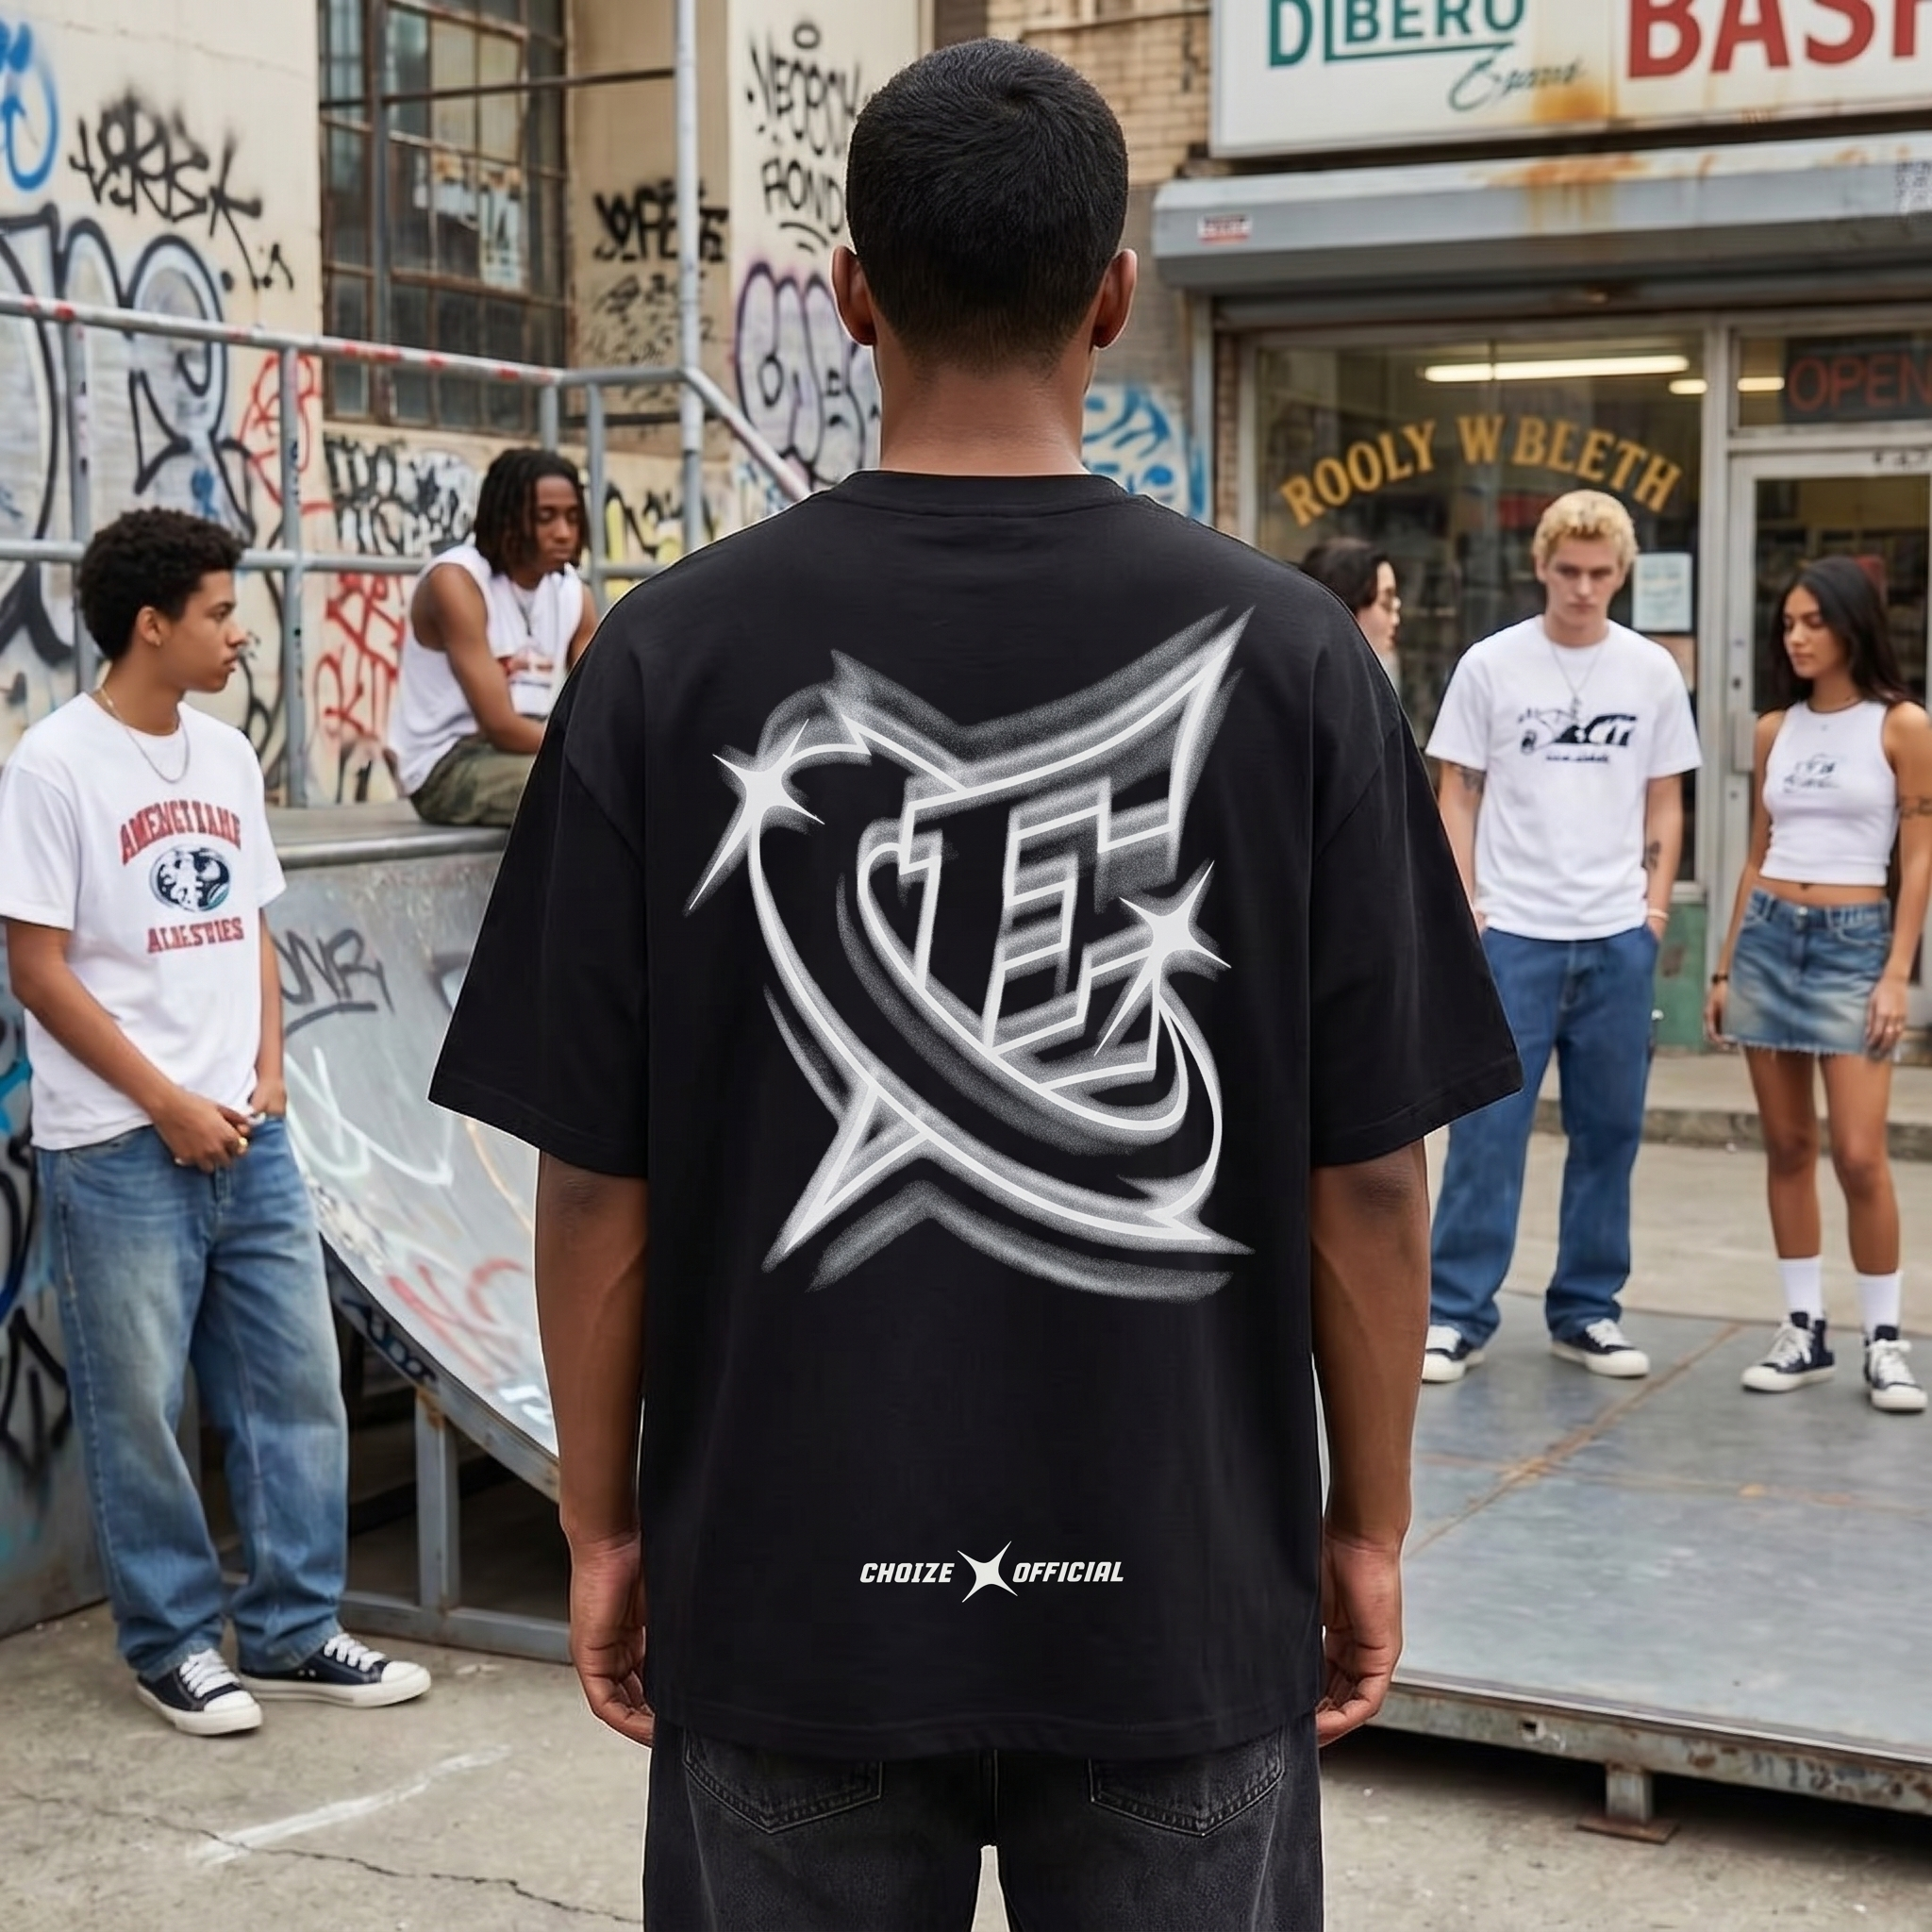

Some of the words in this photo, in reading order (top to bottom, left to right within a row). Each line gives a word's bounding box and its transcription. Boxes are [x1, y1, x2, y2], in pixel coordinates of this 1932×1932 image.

[1788, 353, 1932, 412] OPEN
[1280, 420, 1437, 526] ROOLY
[1457, 415, 1506, 465] W
[859, 1562, 956, 1584] CHOIZE
[1011, 1561, 1124, 1583] OFFICIAL
